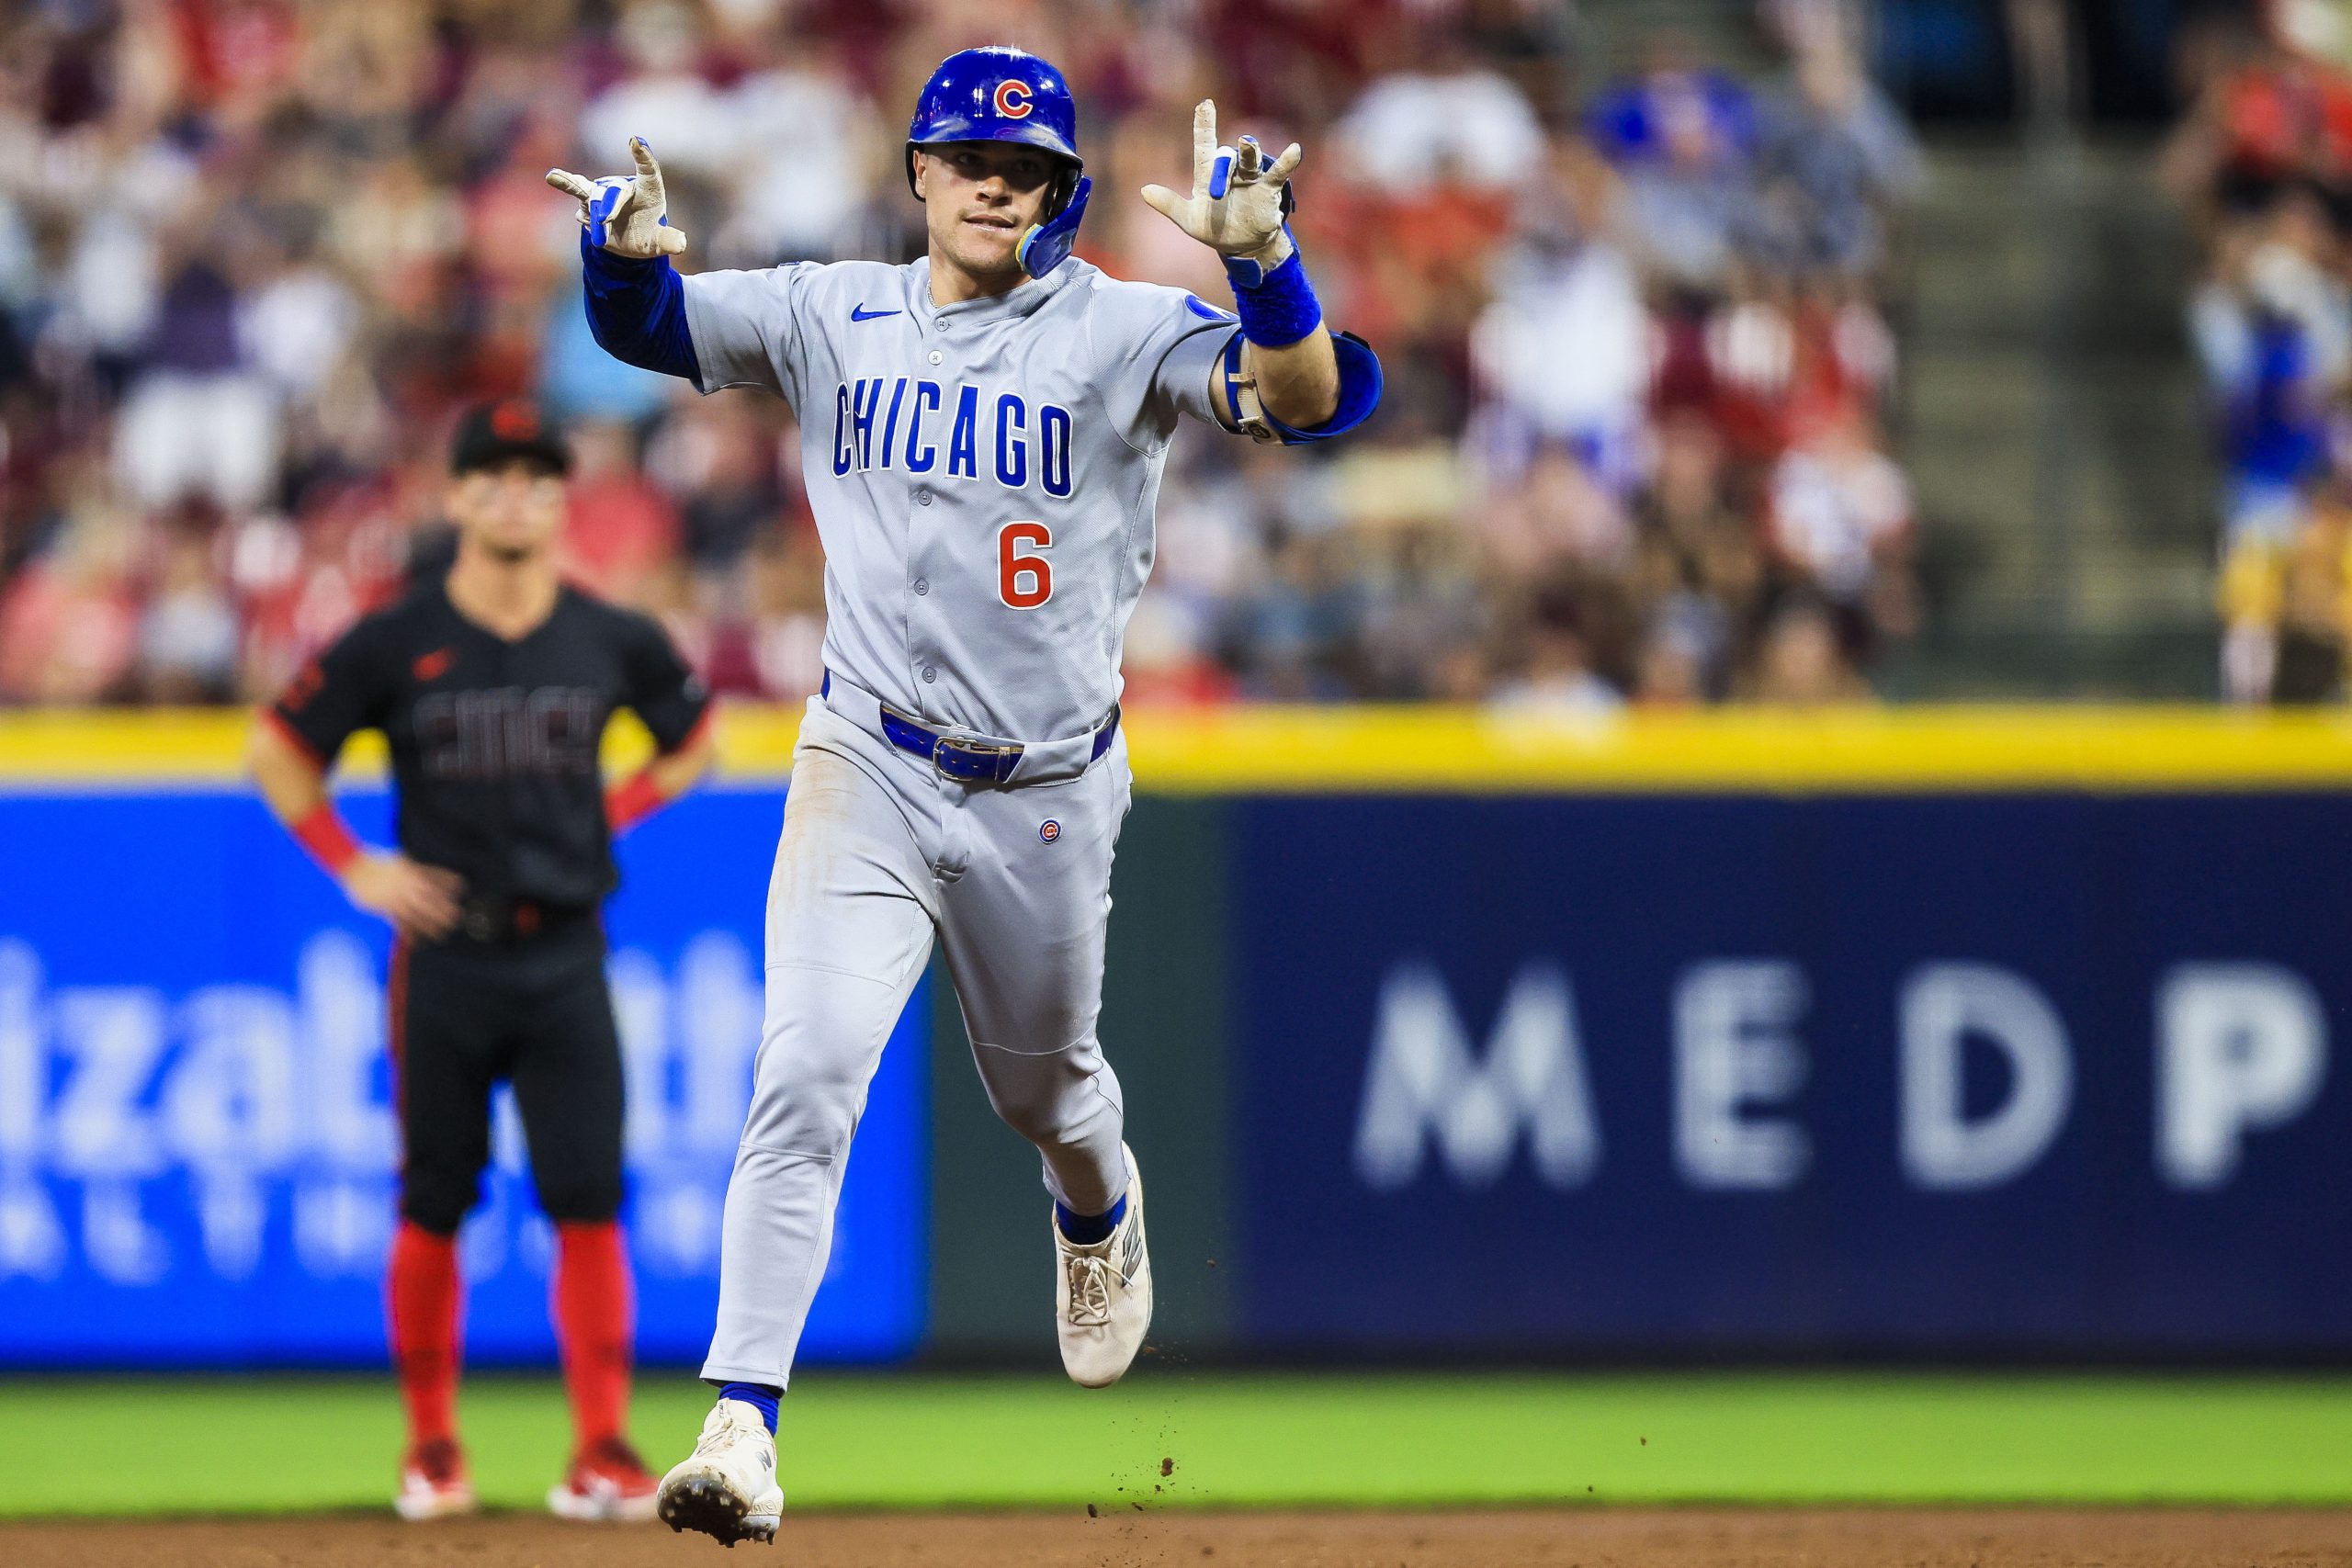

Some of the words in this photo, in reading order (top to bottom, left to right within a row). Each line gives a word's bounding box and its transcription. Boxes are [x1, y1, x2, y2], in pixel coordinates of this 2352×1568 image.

[993, 79, 1033, 119] C
[831, 375, 1073, 499] CHICAGO
[998, 520, 1054, 610] 6
[1353, 958, 2331, 1191] MEDP
